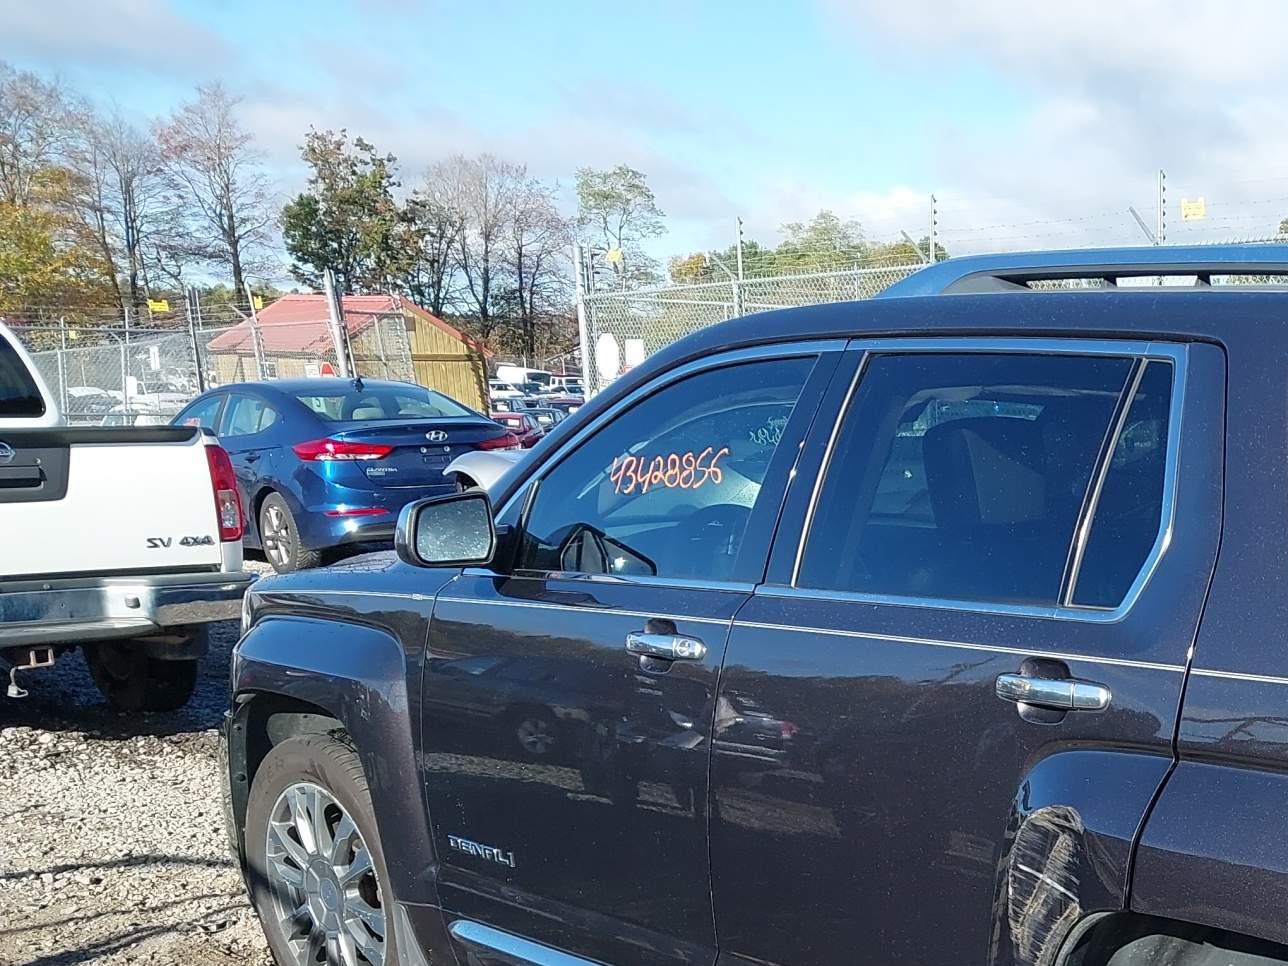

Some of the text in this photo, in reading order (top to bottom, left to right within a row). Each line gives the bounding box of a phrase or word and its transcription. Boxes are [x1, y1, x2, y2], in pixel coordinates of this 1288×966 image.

[610, 446, 729, 495] 43428856
[146, 536, 172, 548] SV
[448, 834, 516, 868] DENALI
